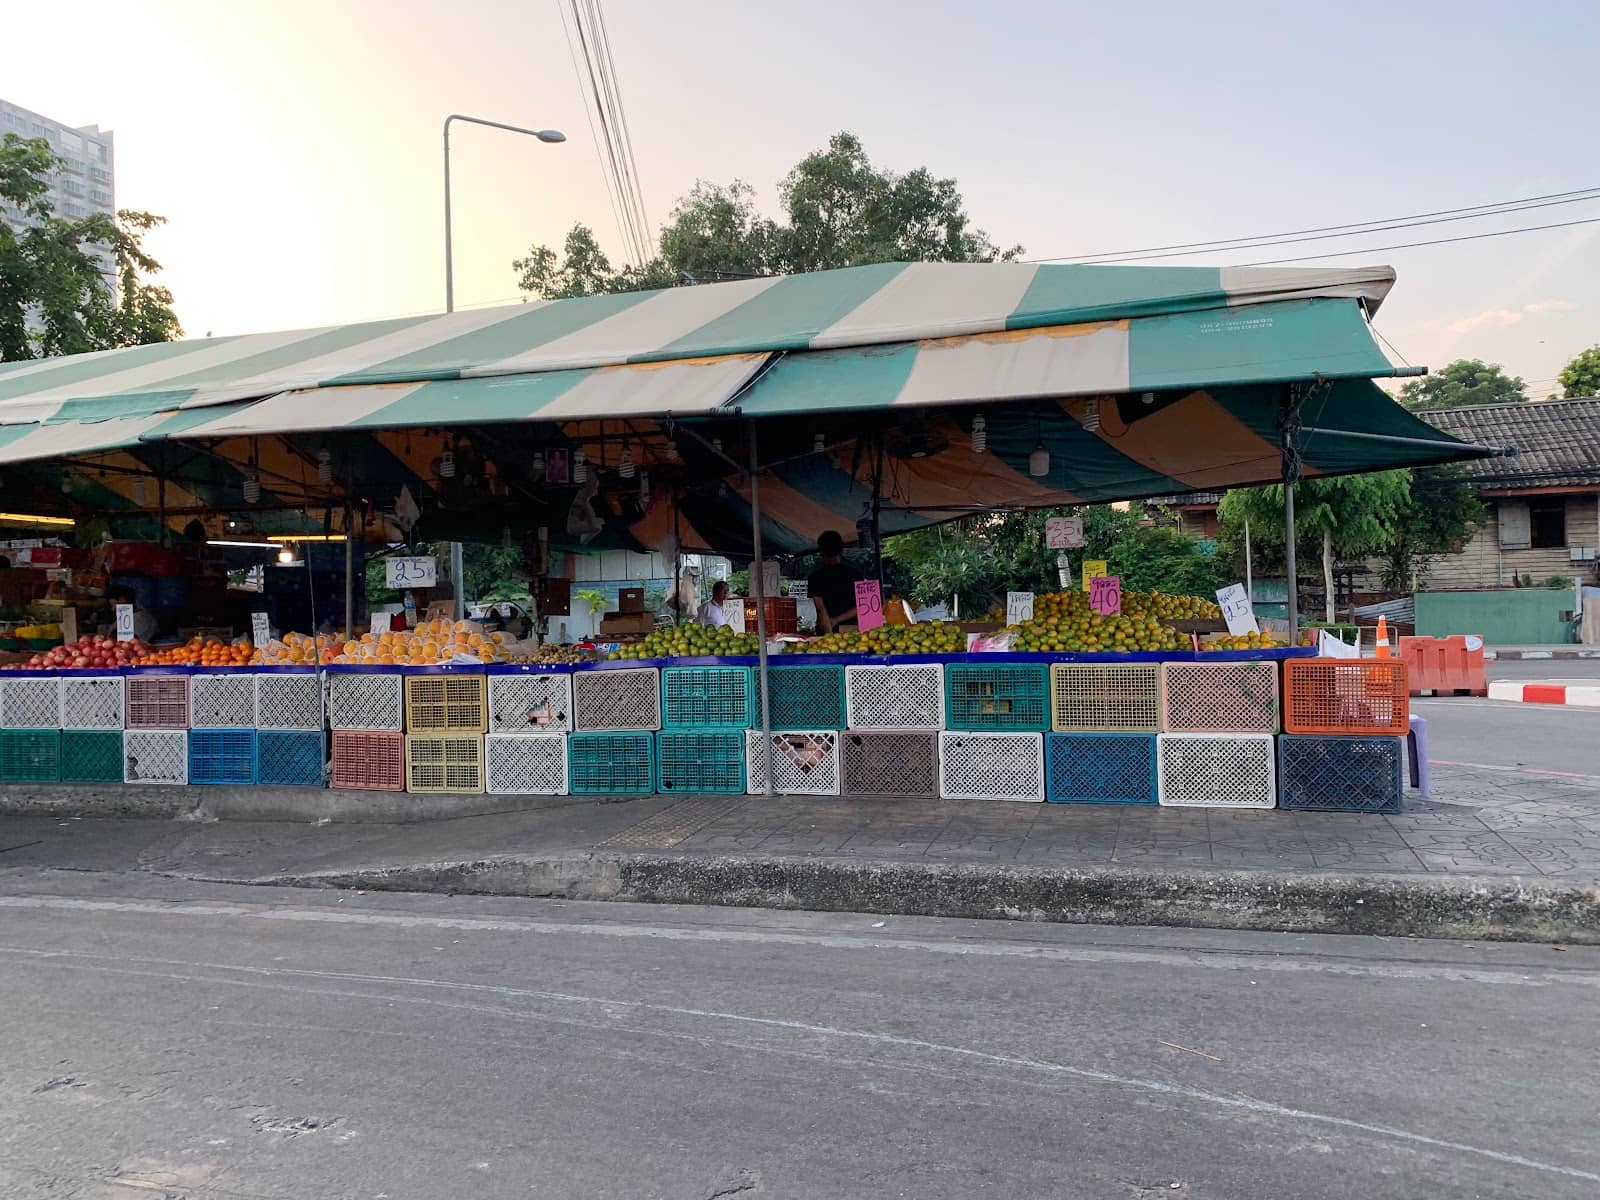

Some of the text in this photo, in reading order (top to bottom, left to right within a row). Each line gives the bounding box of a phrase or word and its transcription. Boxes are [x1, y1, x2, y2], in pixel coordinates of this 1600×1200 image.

[395, 561, 425, 581] 25
[859, 594, 880, 615] 50
[1092, 589, 1118, 611] 40
[1223, 599, 1249, 621] 25
[1008, 604, 1031, 621] 40
